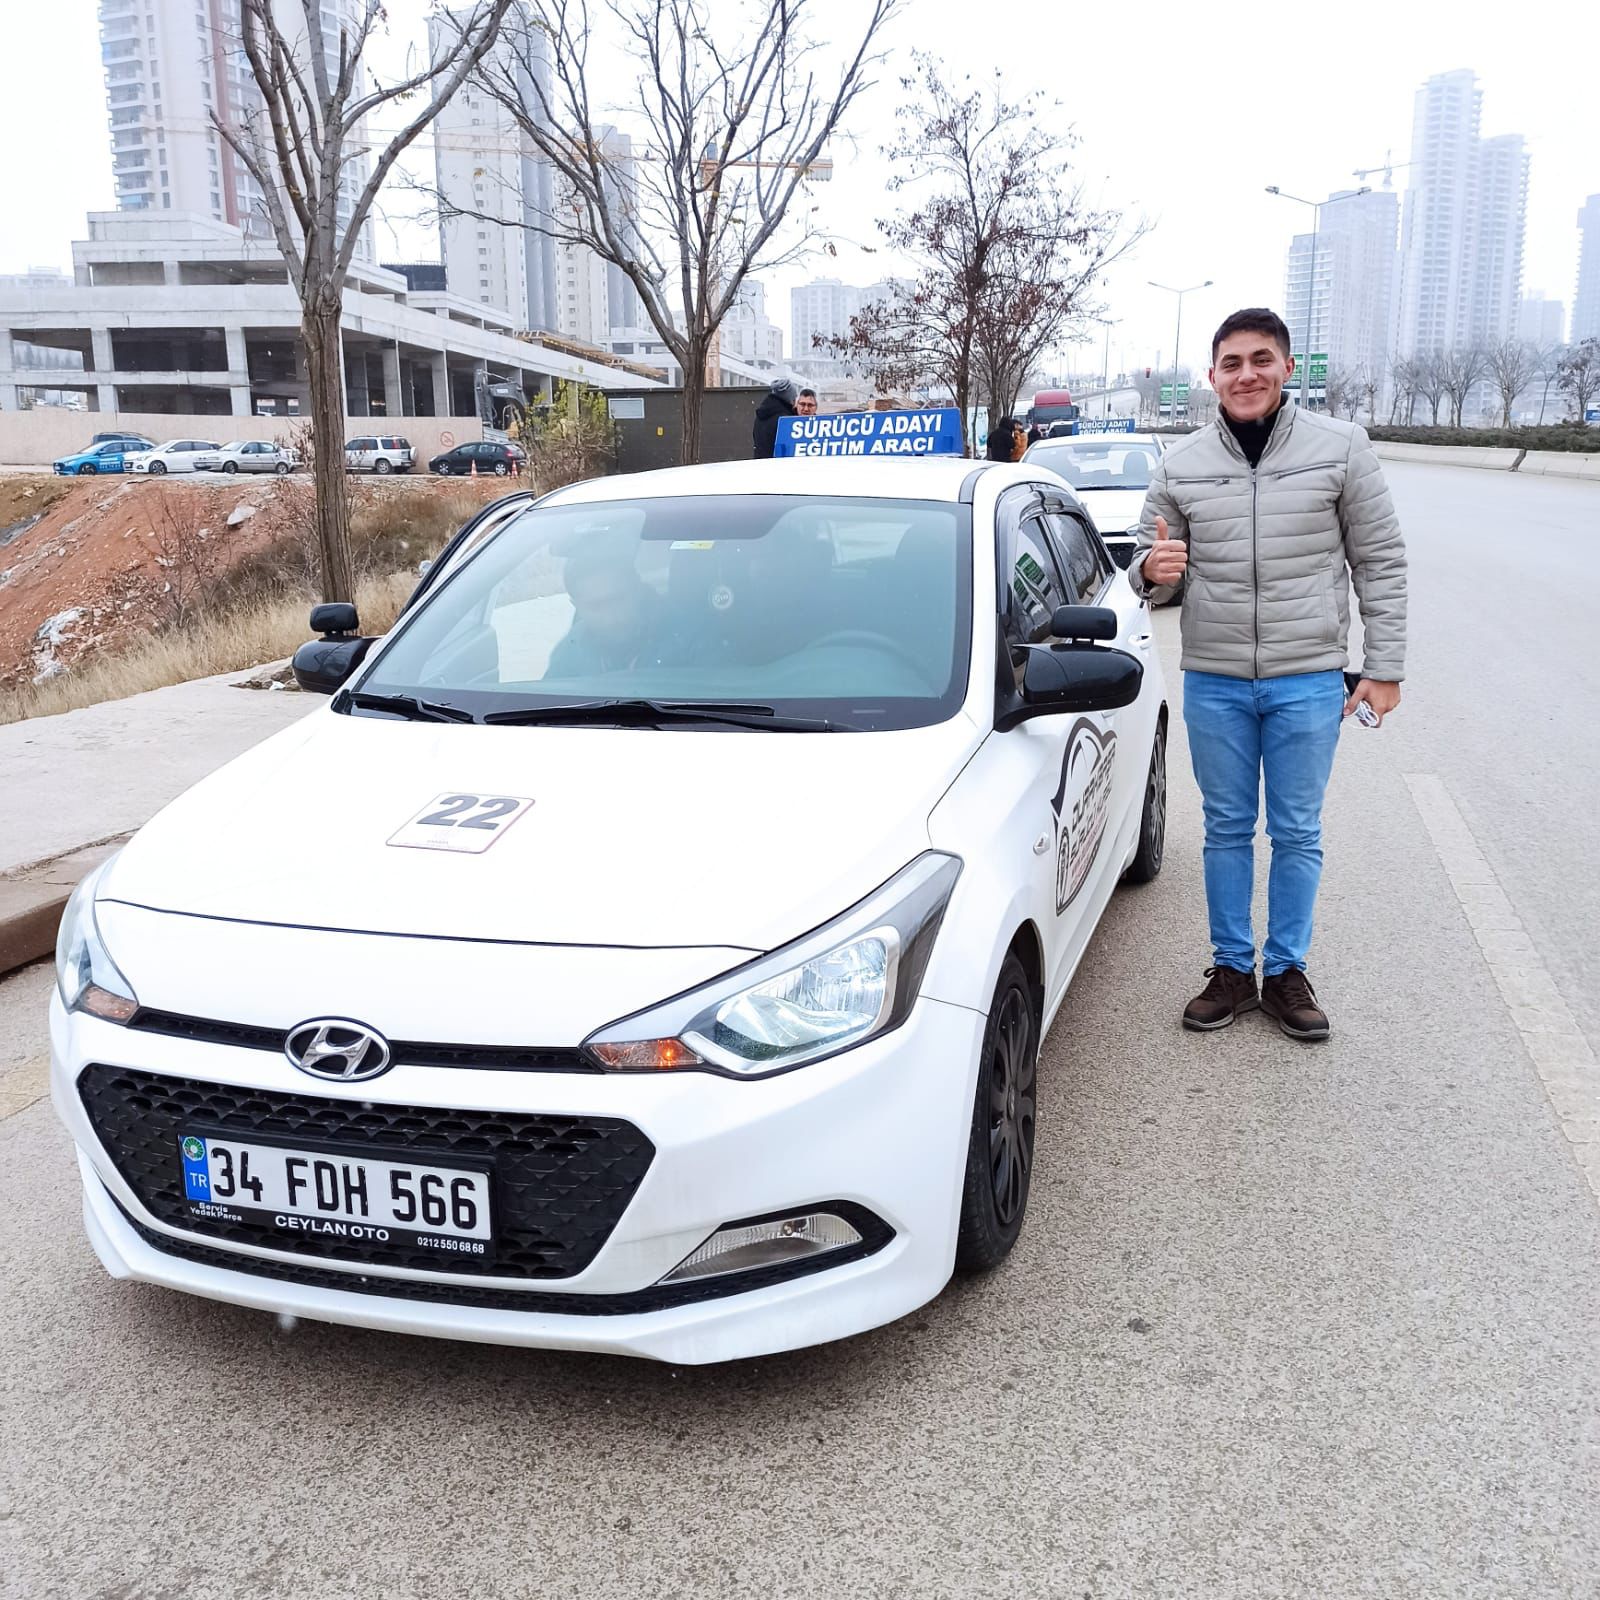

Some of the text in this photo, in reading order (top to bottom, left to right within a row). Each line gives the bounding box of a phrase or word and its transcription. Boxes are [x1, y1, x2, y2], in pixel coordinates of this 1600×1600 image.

[790, 413, 942, 438] SÜRÜCÜ ADAYI
[793, 436, 934, 456] EĞİTİM ARACI
[416, 795, 520, 831] 22
[190, 1172, 208, 1188] TR
[211, 1147, 477, 1230] 34 FDH 566
[275, 1215, 390, 1242] CEYLAN OTO
